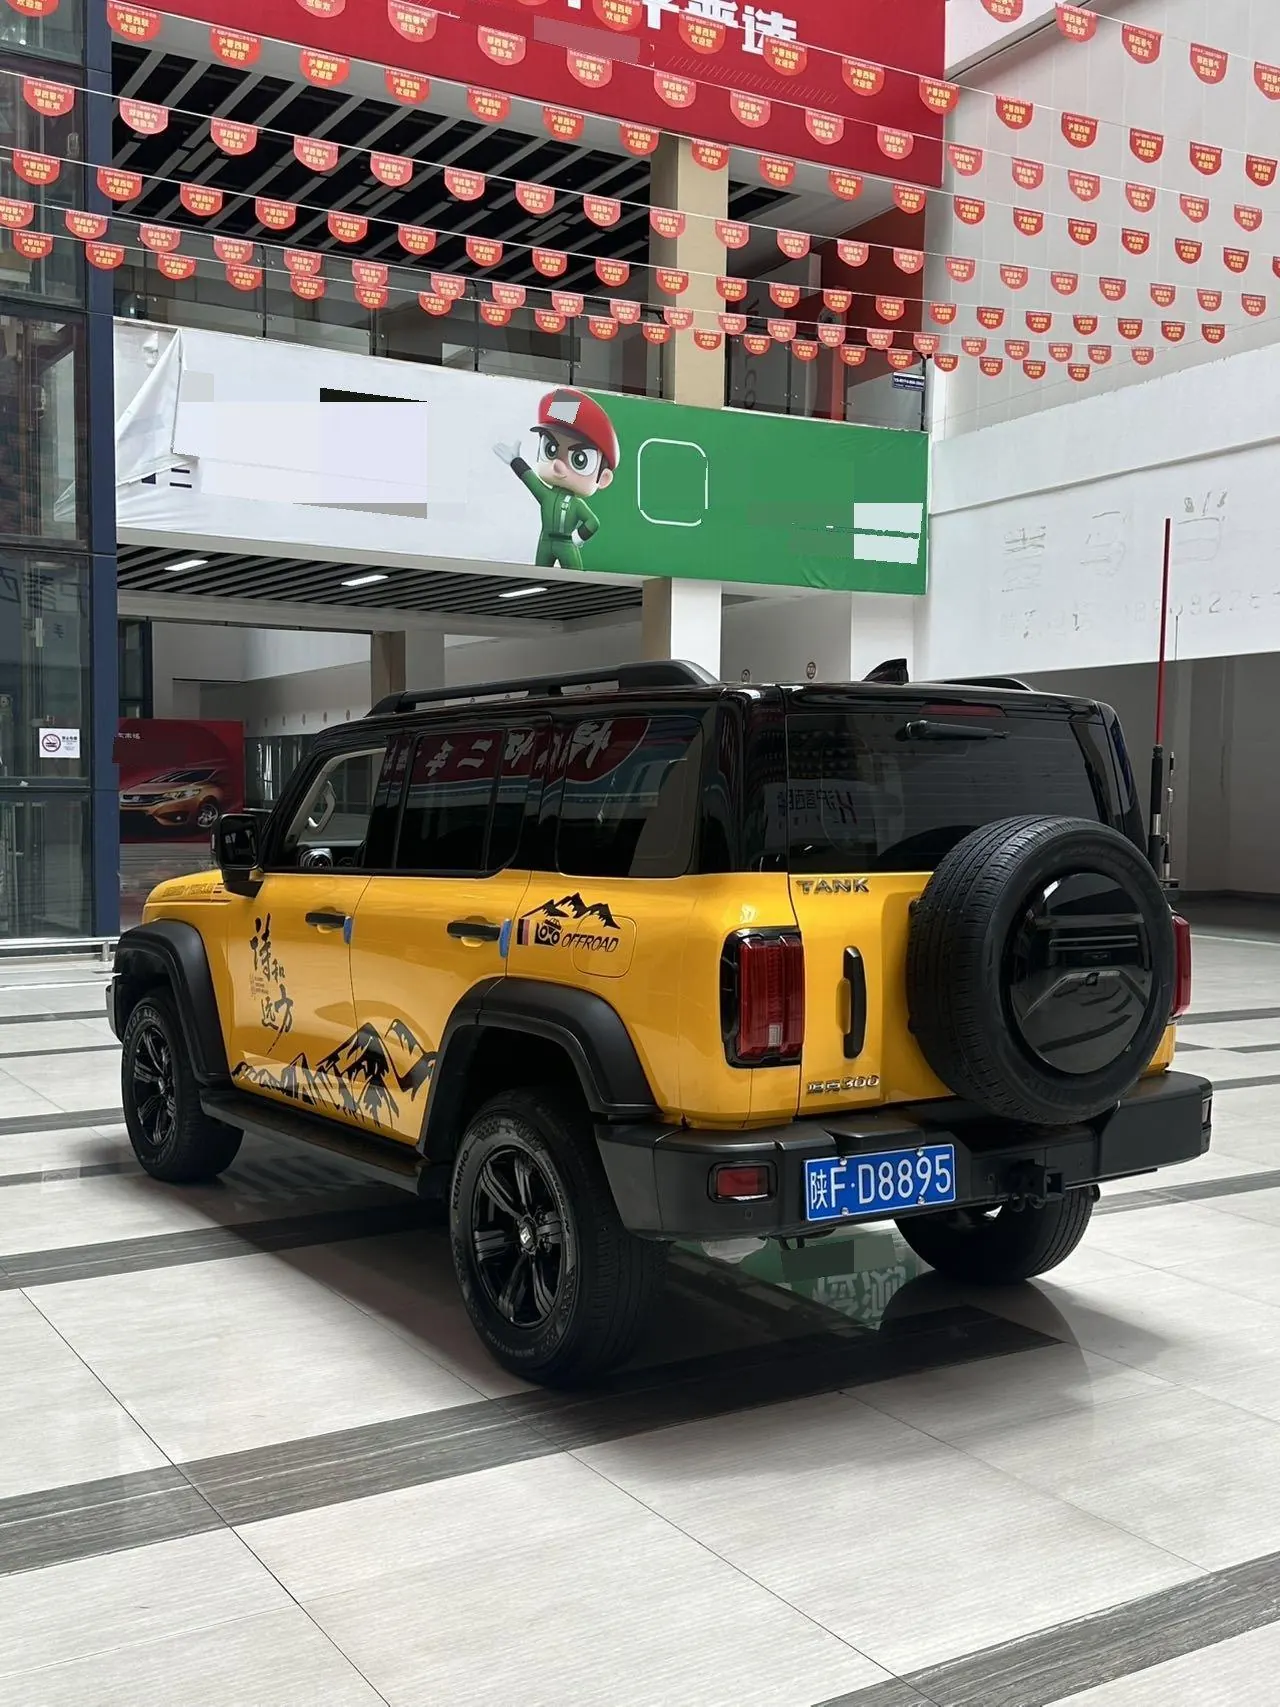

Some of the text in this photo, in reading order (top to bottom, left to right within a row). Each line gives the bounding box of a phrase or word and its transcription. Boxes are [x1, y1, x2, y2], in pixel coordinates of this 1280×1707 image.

[796, 877, 869, 895] TANK
[561, 932, 619, 953] OFFROAD
[806, 1074, 880, 1095] 坦克300
[452, 1150, 470, 1211] KUMHO
